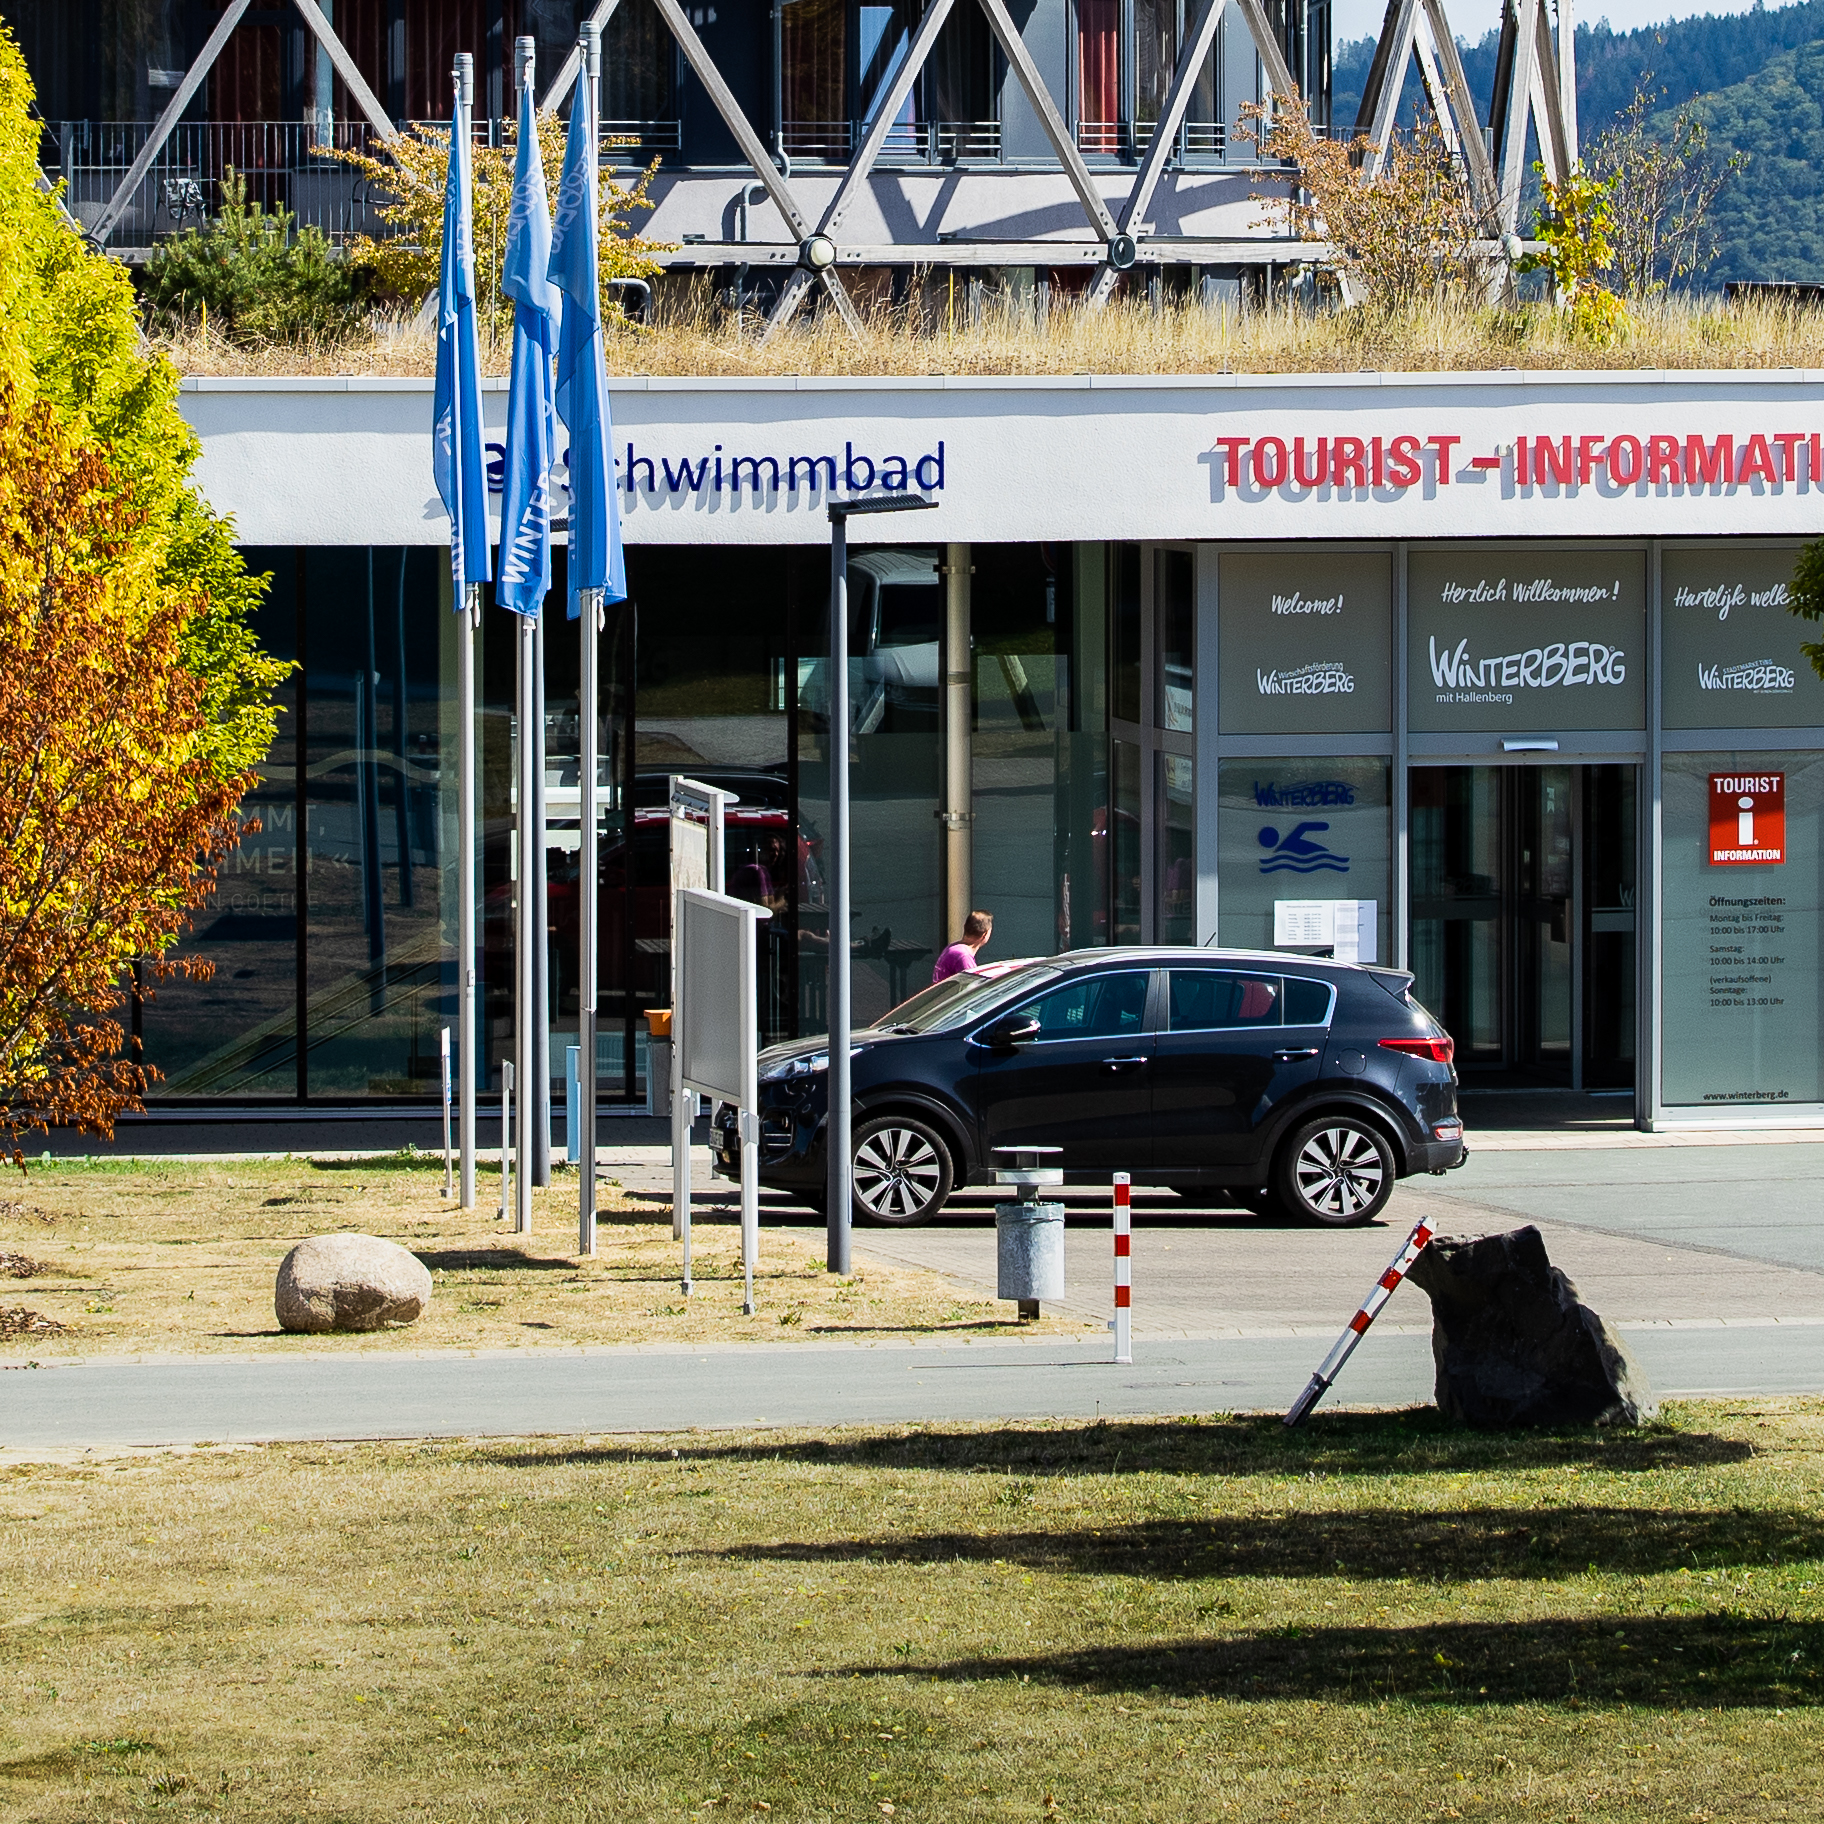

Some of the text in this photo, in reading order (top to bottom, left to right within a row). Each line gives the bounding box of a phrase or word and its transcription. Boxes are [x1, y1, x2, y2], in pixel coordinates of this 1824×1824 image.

[562, 440, 945, 493] hwimmbad
[1216, 435, 1461, 487] TOURIST
[501, 452, 550, 584] WINTER
[1441, 578, 1507, 604] Herzlich
[1271, 591, 1344, 615] Welcome!
[1673, 583, 1810, 621] Hartelijk welk
[1278, 661, 1344, 679] Wirtschaftsförderung
[1435, 692, 1513, 705] mit Hallenberg
[1713, 776, 1780, 793] TOURIST
[1713, 849, 1781, 861] INFORMATION
[1708, 895, 1786, 908] Öffnungszeiten:
[1709, 914, 1784, 924] Montag bis Freitag:
[1710, 925, 1785, 935] 10:00 bis 17:00 Uhr
[1709, 945, 1745, 954] Samstag:
[1710, 956, 1785, 966] 10:00 bis 14:00 Uhr
[1709, 974, 1772, 985] (verkaufsoffene)
[1710, 997, 1784, 1007] 10:00 bis 13:00 Uhr
[1702, 1089, 1789, 1100] www.winterberg.de
